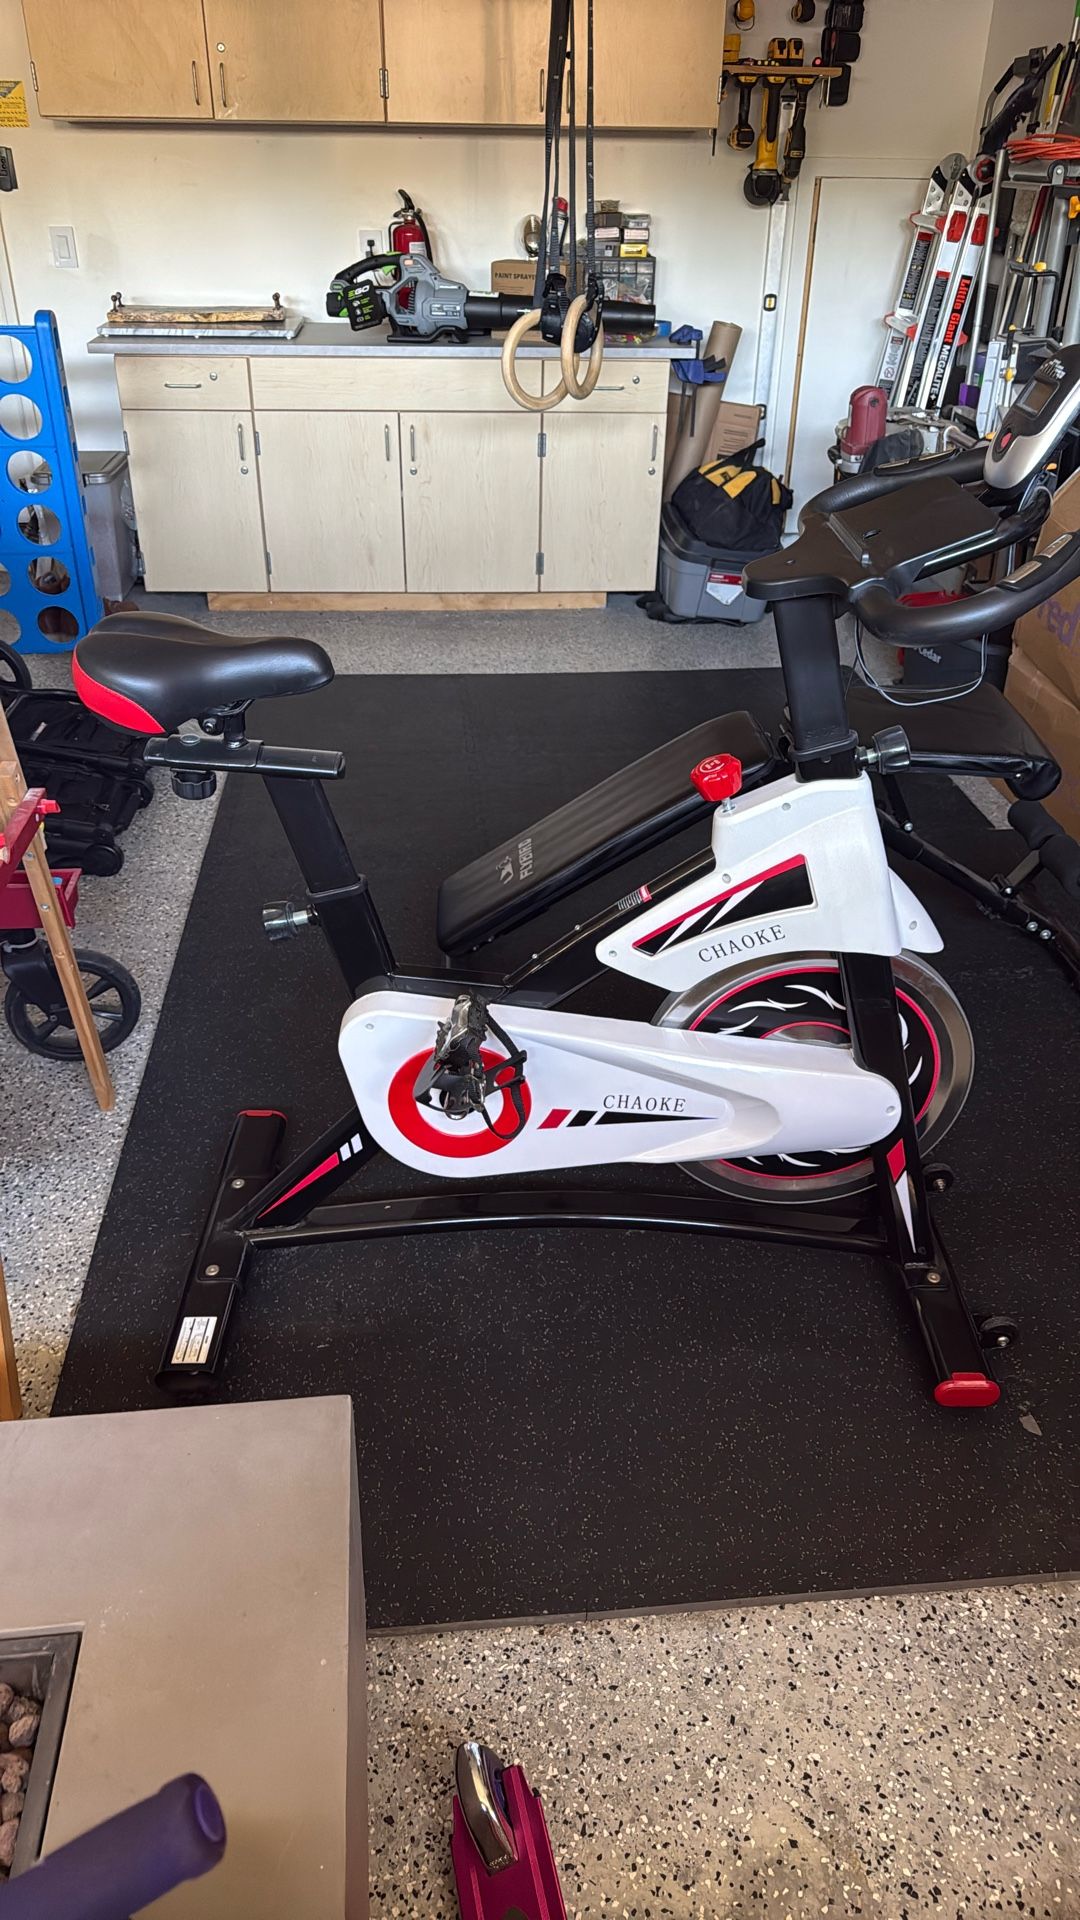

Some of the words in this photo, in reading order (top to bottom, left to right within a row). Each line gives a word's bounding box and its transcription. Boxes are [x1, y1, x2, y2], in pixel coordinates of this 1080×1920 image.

[347, 285, 370, 298] EGO
[953, 278, 971, 310] Little
[943, 312, 961, 344] Giant
[518, 838, 534, 880] FLYBIRD
[698, 924, 786, 963] CHAOKE
[603, 1094, 686, 1113] CHAOKE
